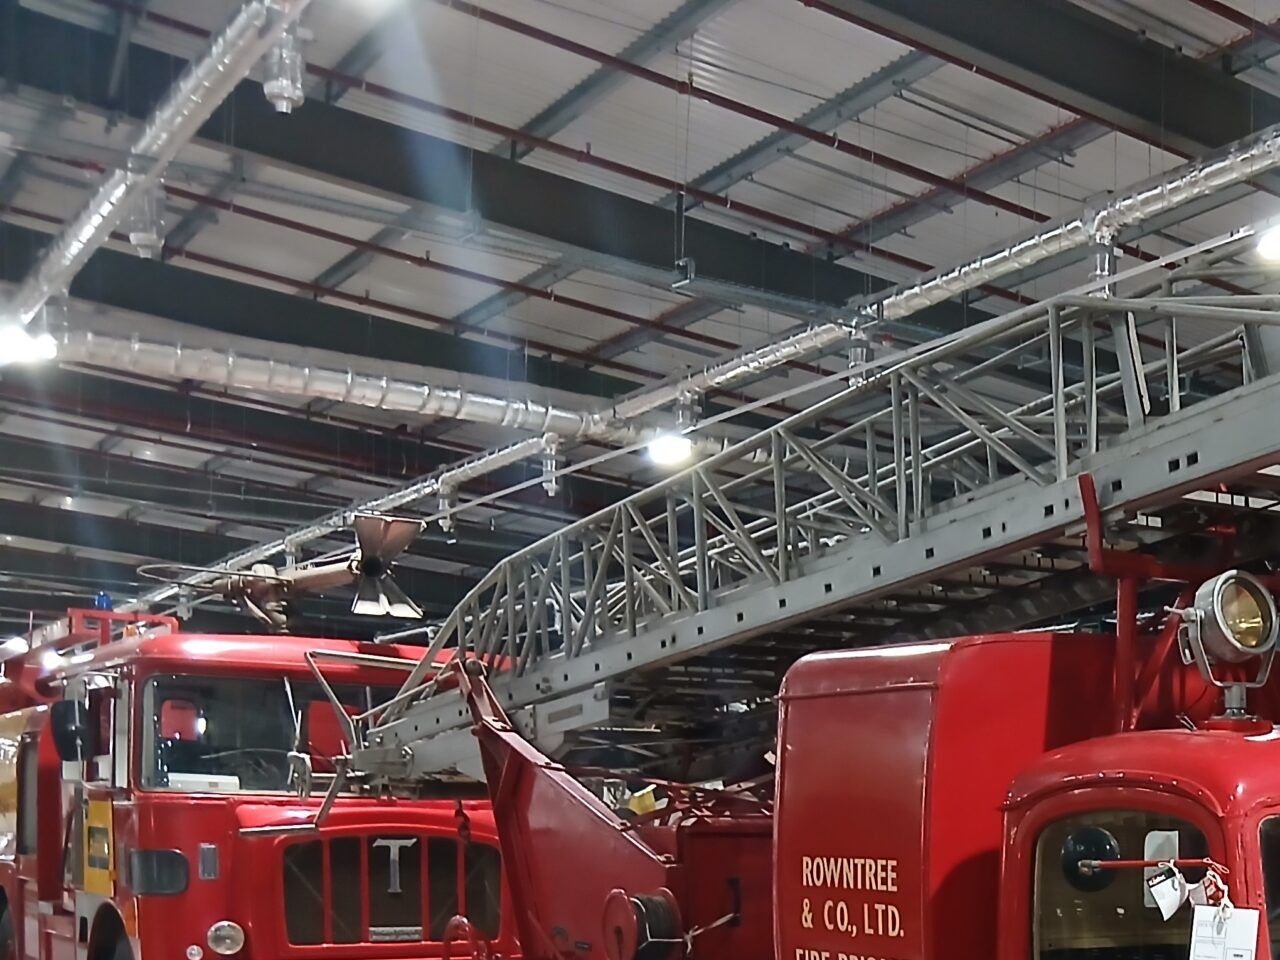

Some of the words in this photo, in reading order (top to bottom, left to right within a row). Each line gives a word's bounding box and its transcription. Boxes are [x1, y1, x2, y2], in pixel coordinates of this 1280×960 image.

[372, 838, 417, 893] T
[802, 856, 898, 892] ROWNTREE
[801, 898, 814, 929] &
[823, 900, 858, 937] CO.,
[863, 903, 904, 938] LTD.
